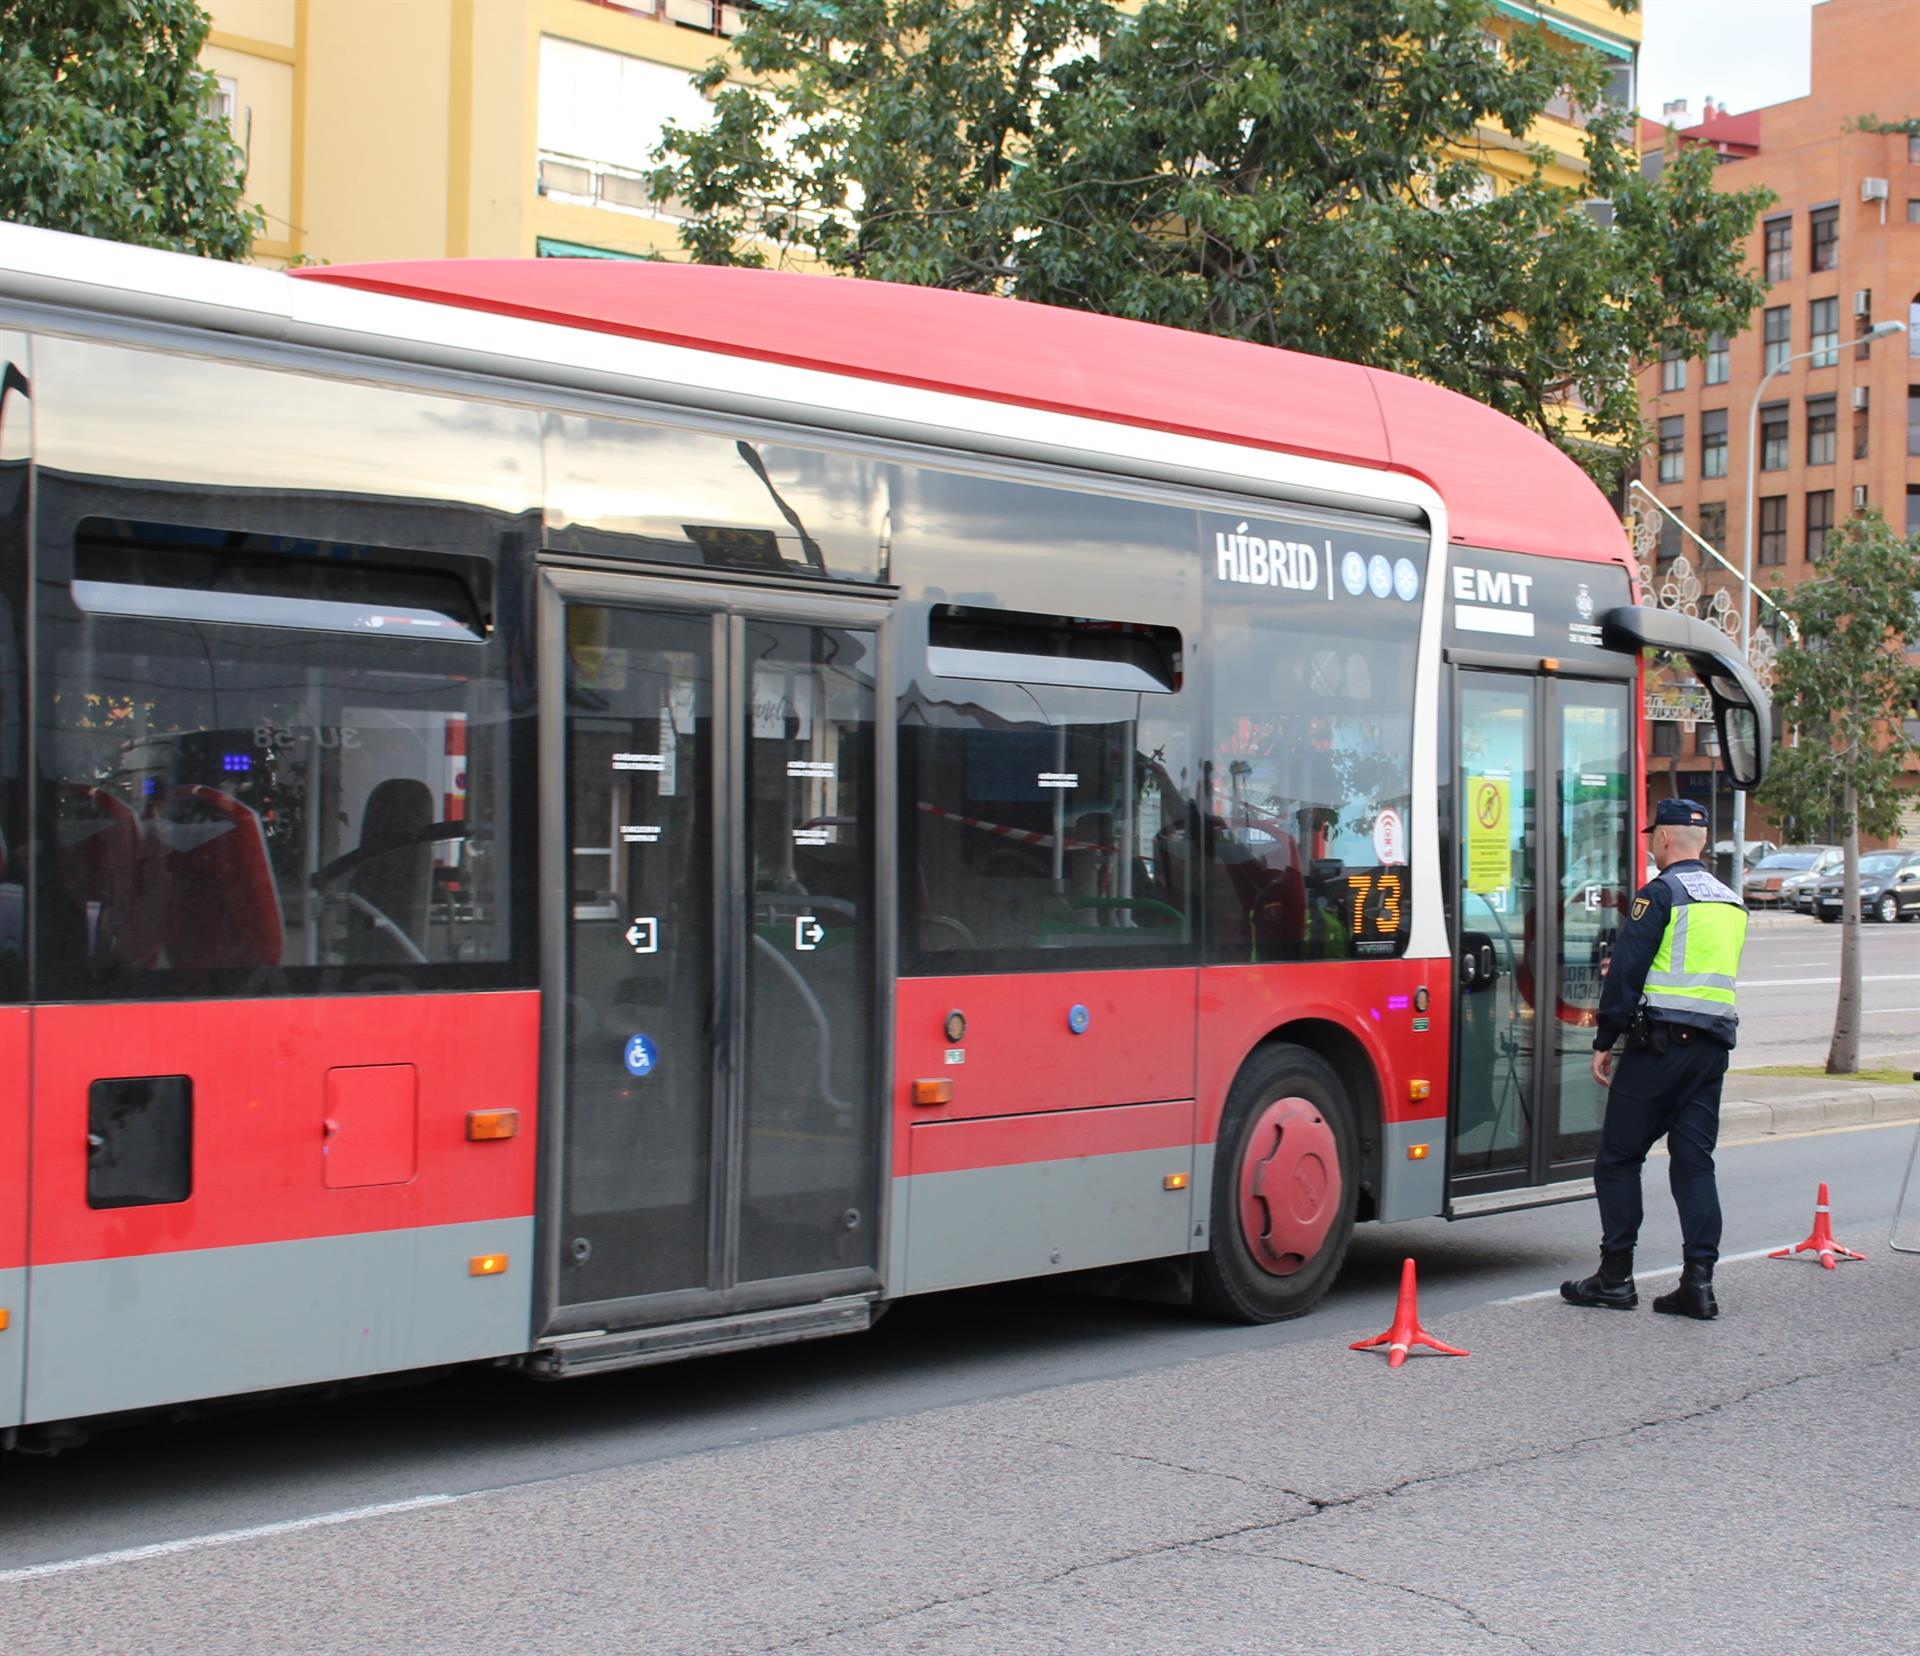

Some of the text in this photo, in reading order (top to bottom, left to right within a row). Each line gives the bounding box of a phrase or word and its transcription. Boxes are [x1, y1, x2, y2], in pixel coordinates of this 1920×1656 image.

[1216, 521, 1317, 590] HÍBRID
[1452, 567, 1533, 606] EMT
[1350, 875, 1400, 934] 73
